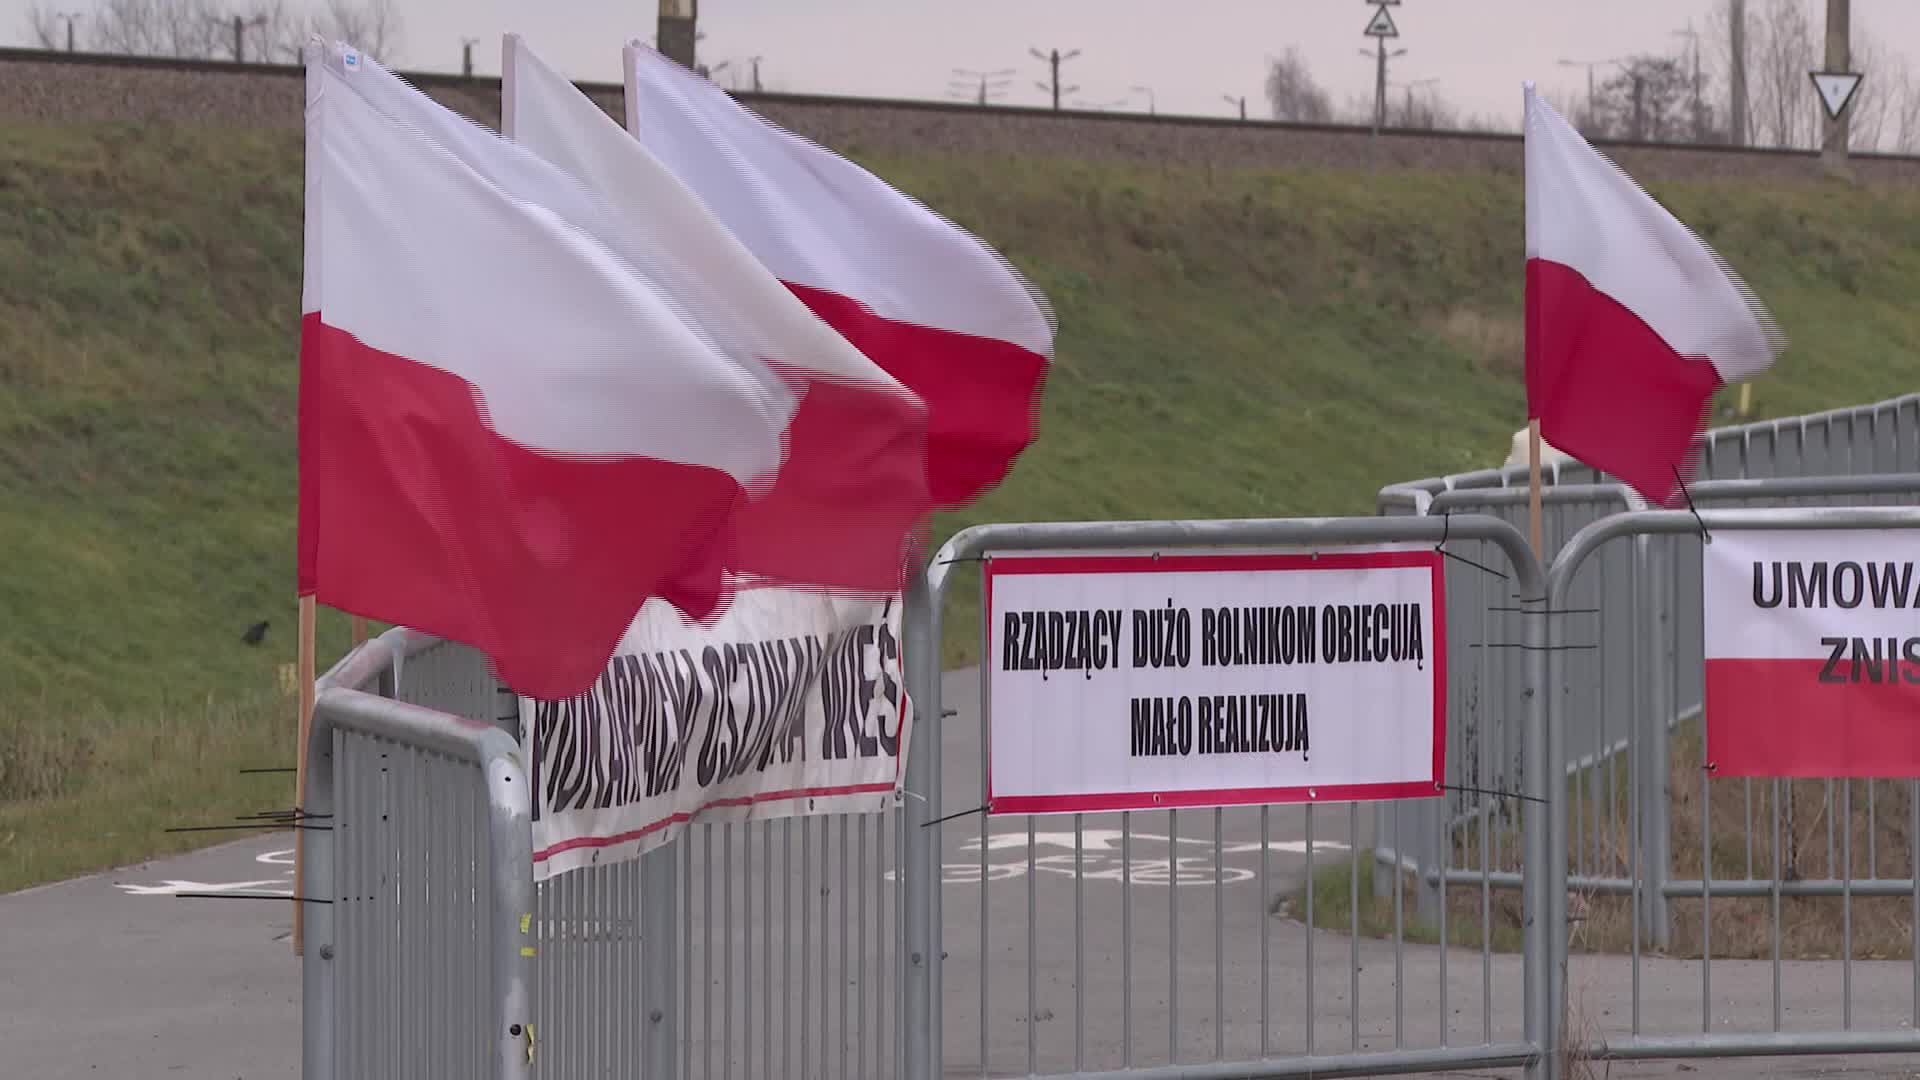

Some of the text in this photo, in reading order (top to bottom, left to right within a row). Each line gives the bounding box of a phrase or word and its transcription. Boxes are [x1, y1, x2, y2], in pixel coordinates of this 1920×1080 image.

[1753, 561, 1920, 609] UMOW
[1003, 598, 1424, 681] RZĄDZĄCY DUŻO ROLNIKOM OBIECUJĄ
[821, 597, 898, 761] WIEŚ
[1131, 693, 1309, 762] MAŁO REALIZUJĄ
